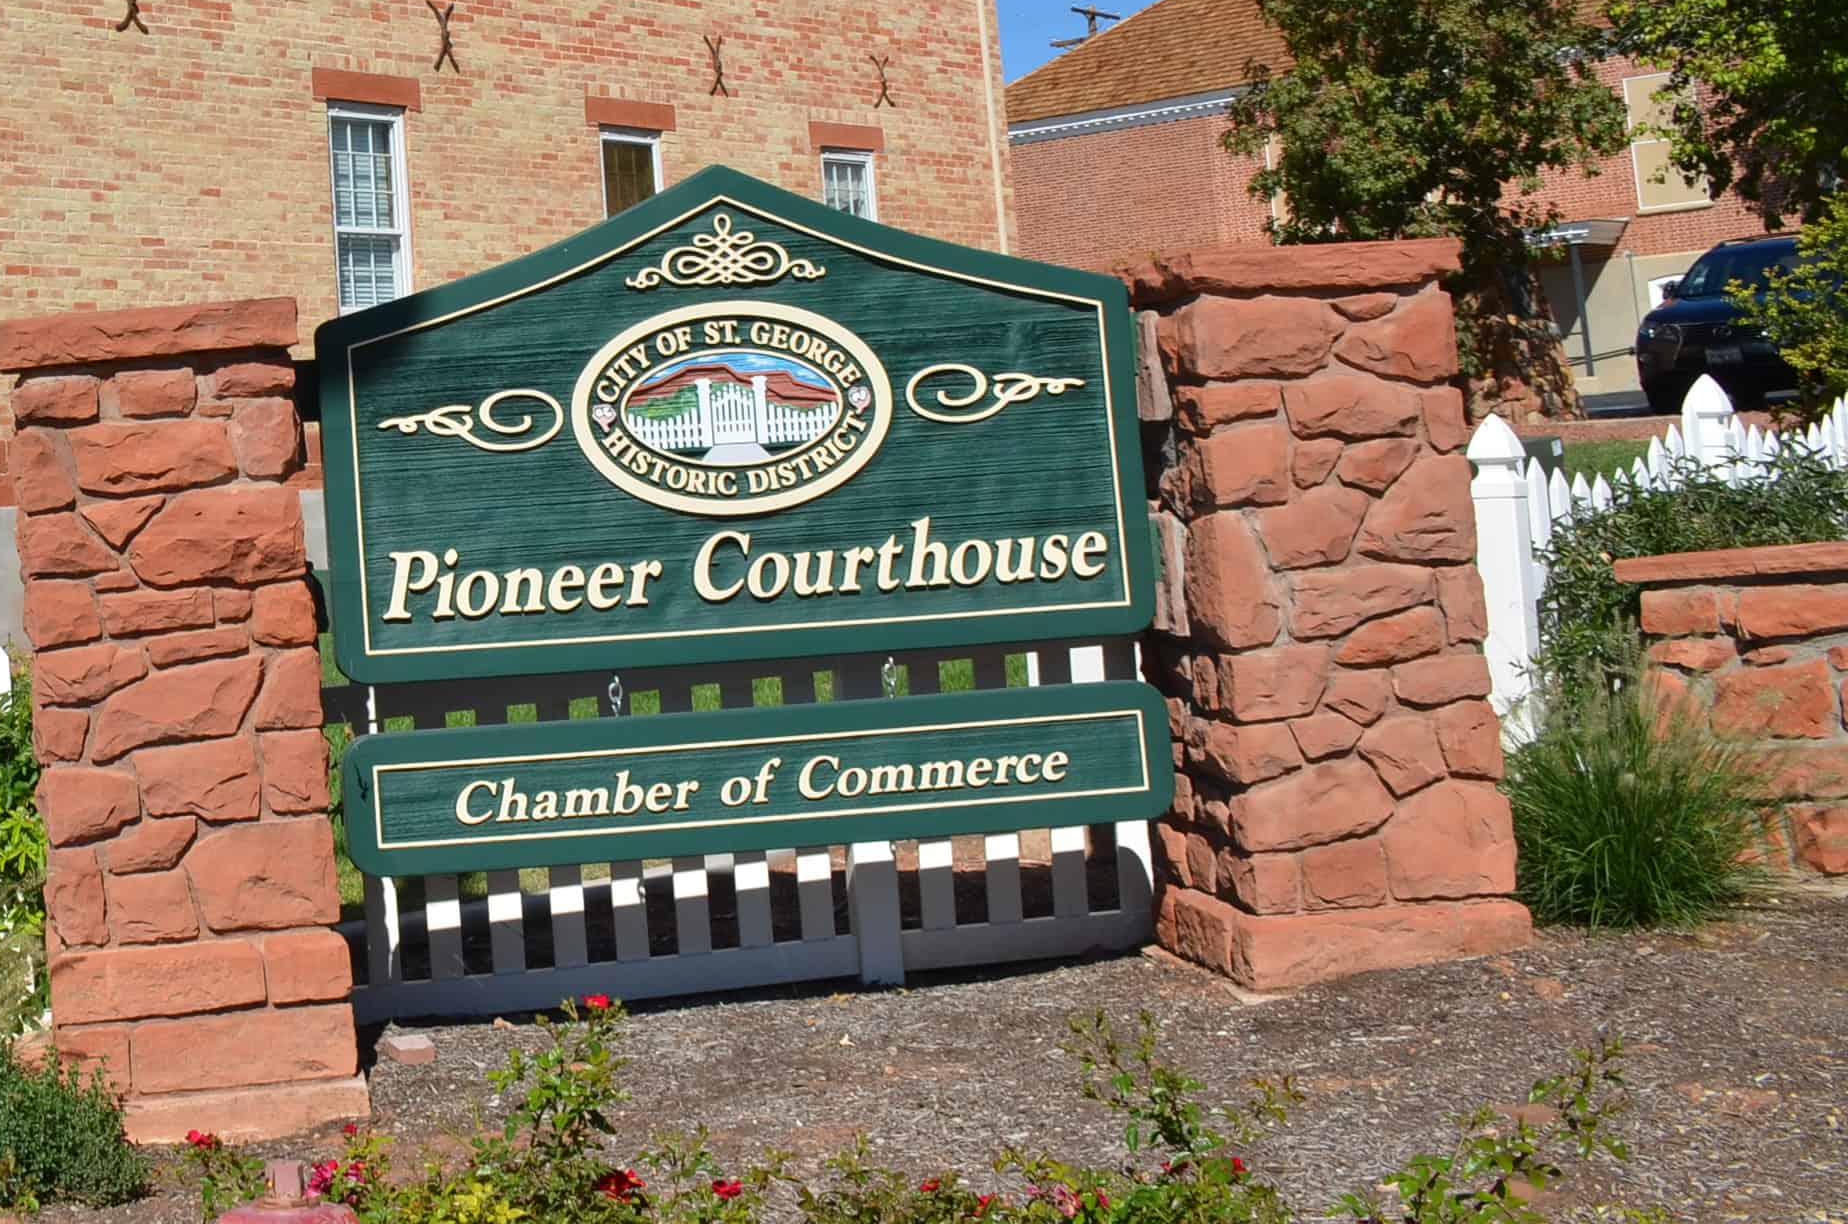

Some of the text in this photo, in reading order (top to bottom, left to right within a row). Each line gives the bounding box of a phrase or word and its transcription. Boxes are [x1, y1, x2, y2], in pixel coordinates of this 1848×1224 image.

[597, 320, 862, 403] CITY OF ST. GEORGE
[602, 409, 866, 496] HISTORIC DISTRICT
[382, 517, 1108, 623] Pioneer Courthouse
[455, 751, 1069, 825] Chamber of Commerce
